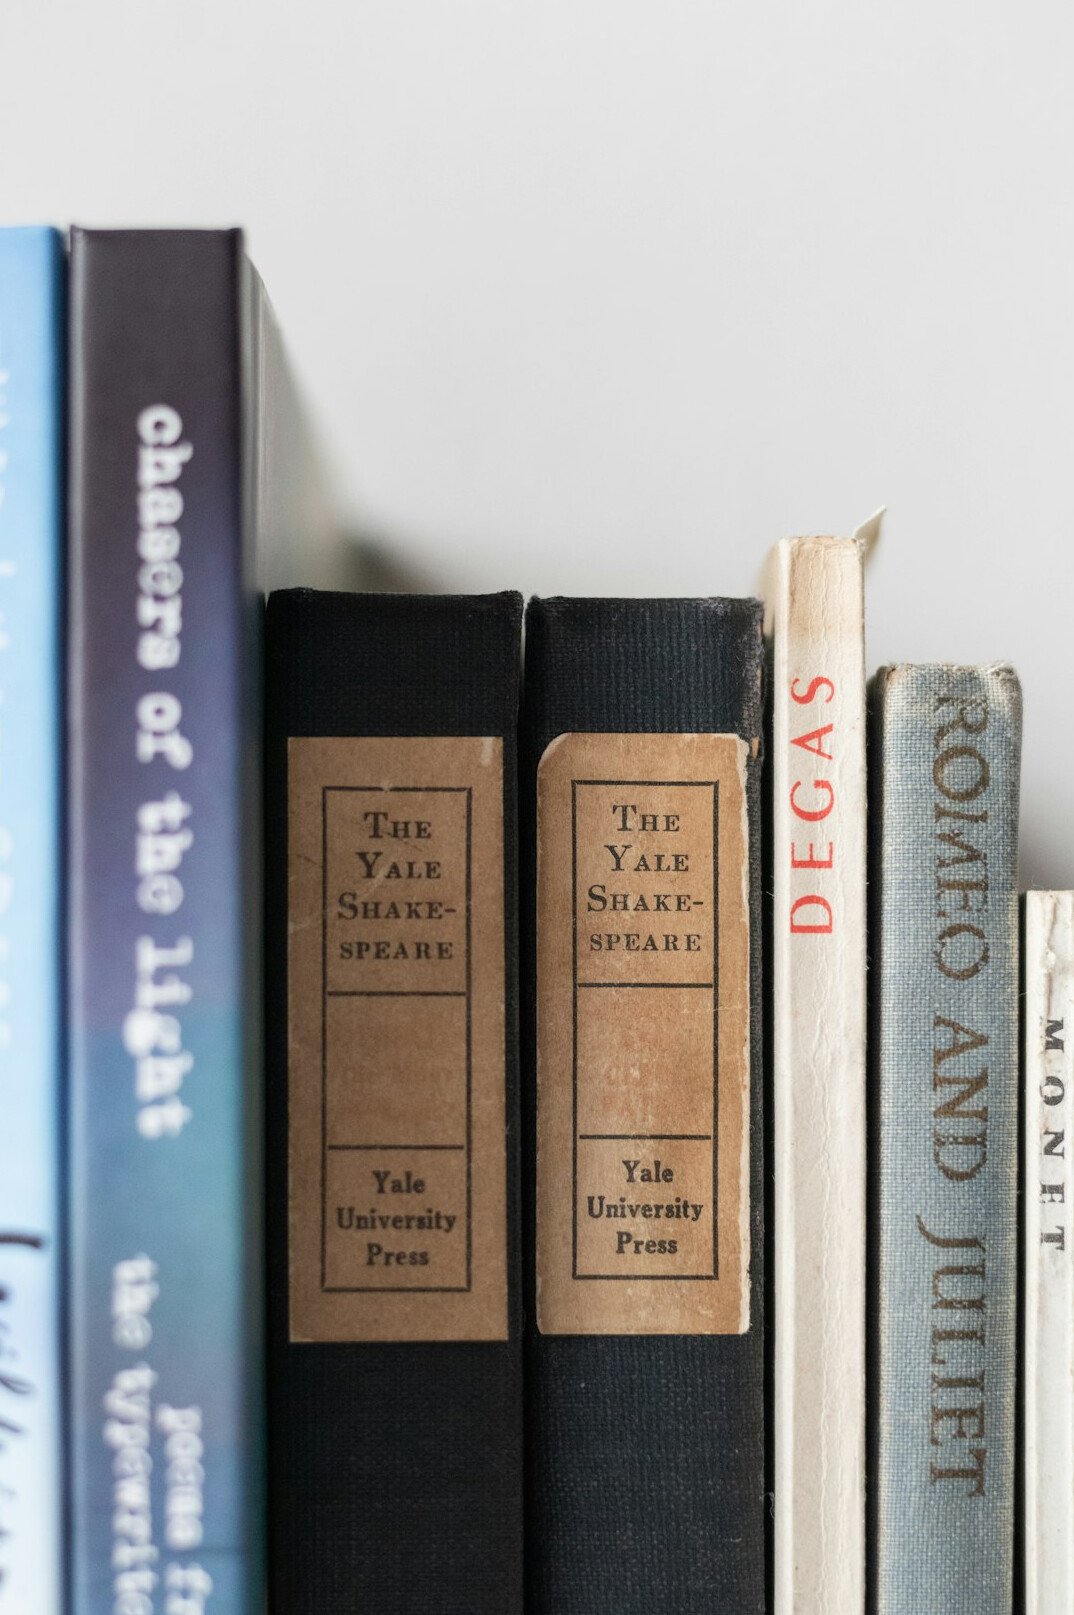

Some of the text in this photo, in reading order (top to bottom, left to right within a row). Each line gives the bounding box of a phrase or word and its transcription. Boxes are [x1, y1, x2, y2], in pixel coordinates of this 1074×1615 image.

[124, 404, 193, 1139] chasers of the light
[612, 804, 681, 833] THE
[790, 675, 835, 934] DEGAS
[364, 811, 432, 840] THE
[356, 851, 441, 880] YALE
[605, 844, 690, 873] YALE
[337, 892, 457, 921] SHAKE-
[587, 885, 704, 912] SHAKE-
[340, 941, 454, 960] SPEARE
[590, 932, 702, 952] SPEARE
[916, 696, 990, 1496] ROMEO AND JULIET
[1040, 1016, 1065, 1251] MONET
[372, 1171, 425, 1195] Yale
[622, 1160, 675, 1184] Yale
[336, 1207, 457, 1234] University
[587, 1197, 704, 1222] University
[366, 1243, 430, 1267] Press
[616, 1231, 679, 1255] Press
[112, 1253, 159, 1350] the
